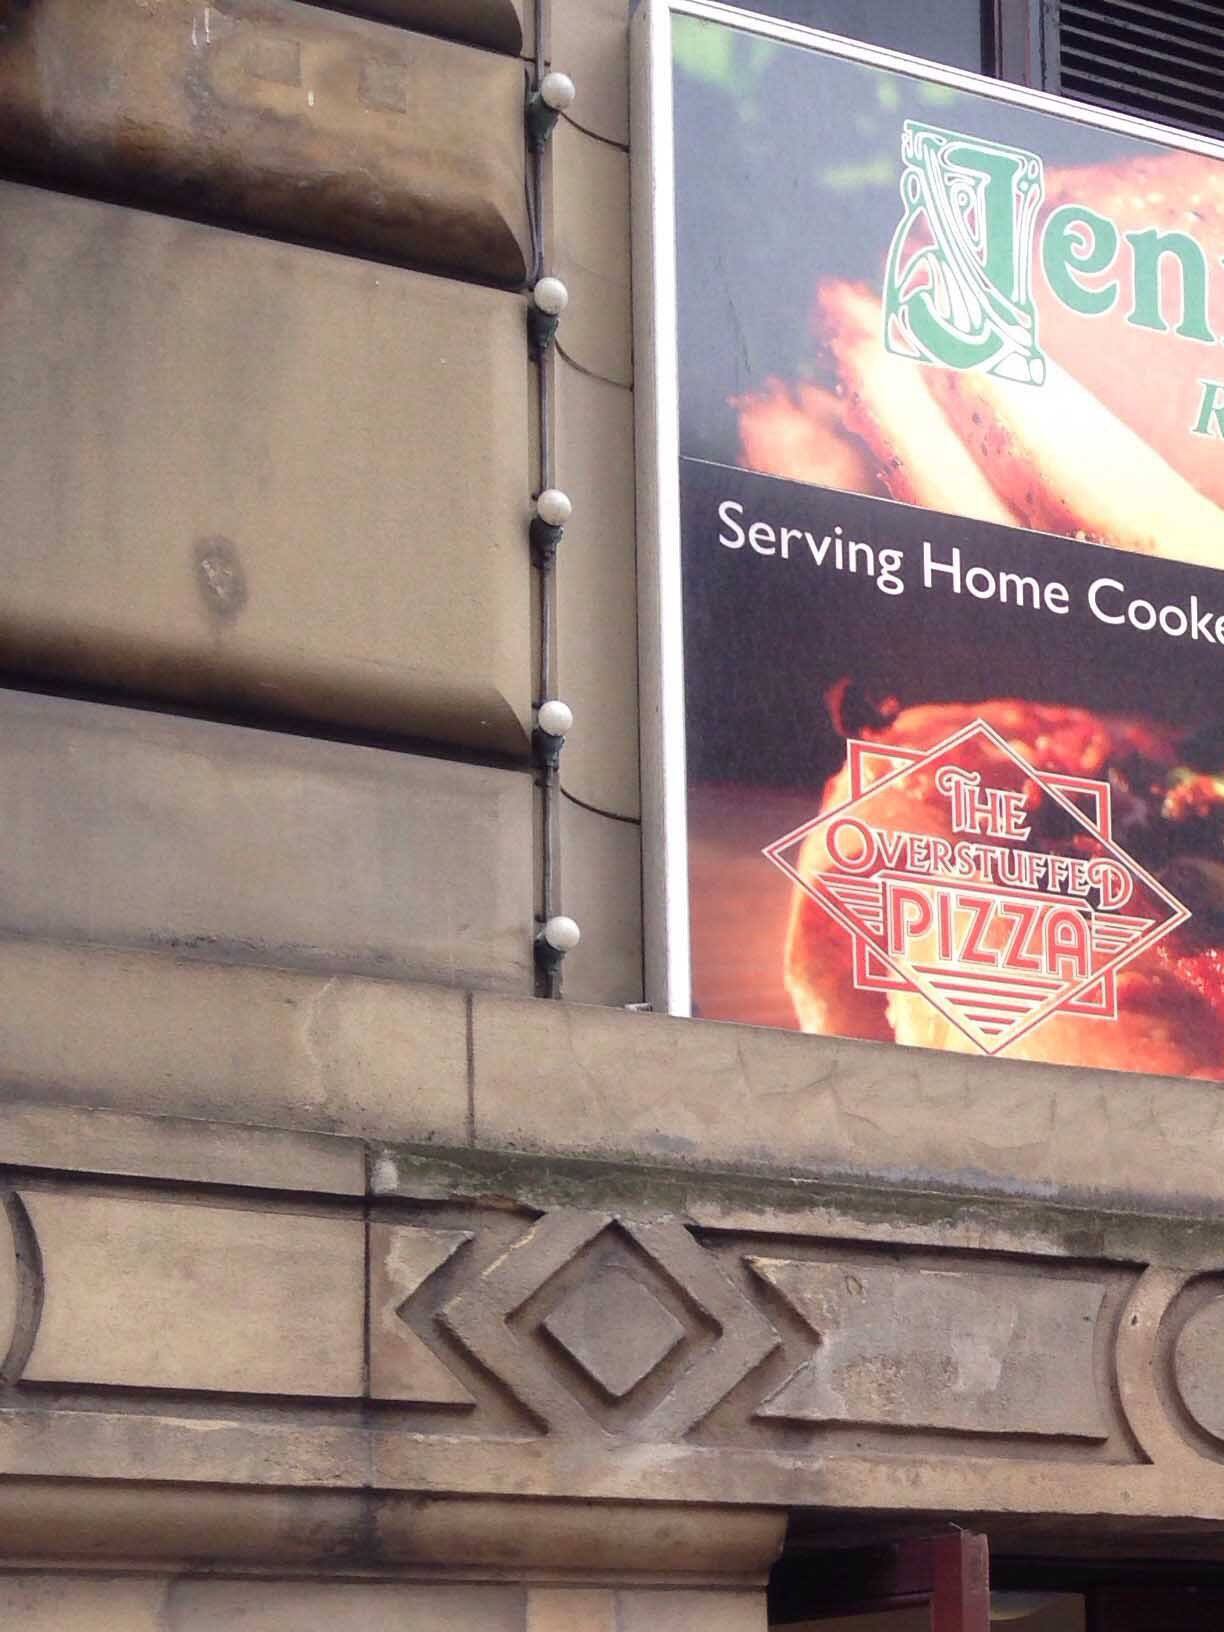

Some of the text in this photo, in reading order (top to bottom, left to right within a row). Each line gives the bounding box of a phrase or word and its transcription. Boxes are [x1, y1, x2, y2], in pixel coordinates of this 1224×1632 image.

[718, 502, 903, 592] Serving
[923, 547, 1071, 615] Home
[936, 766, 1030, 841] THE
[825, 819, 1132, 912] OVERSTUFFED
[890, 888, 1091, 979] PIZZA
